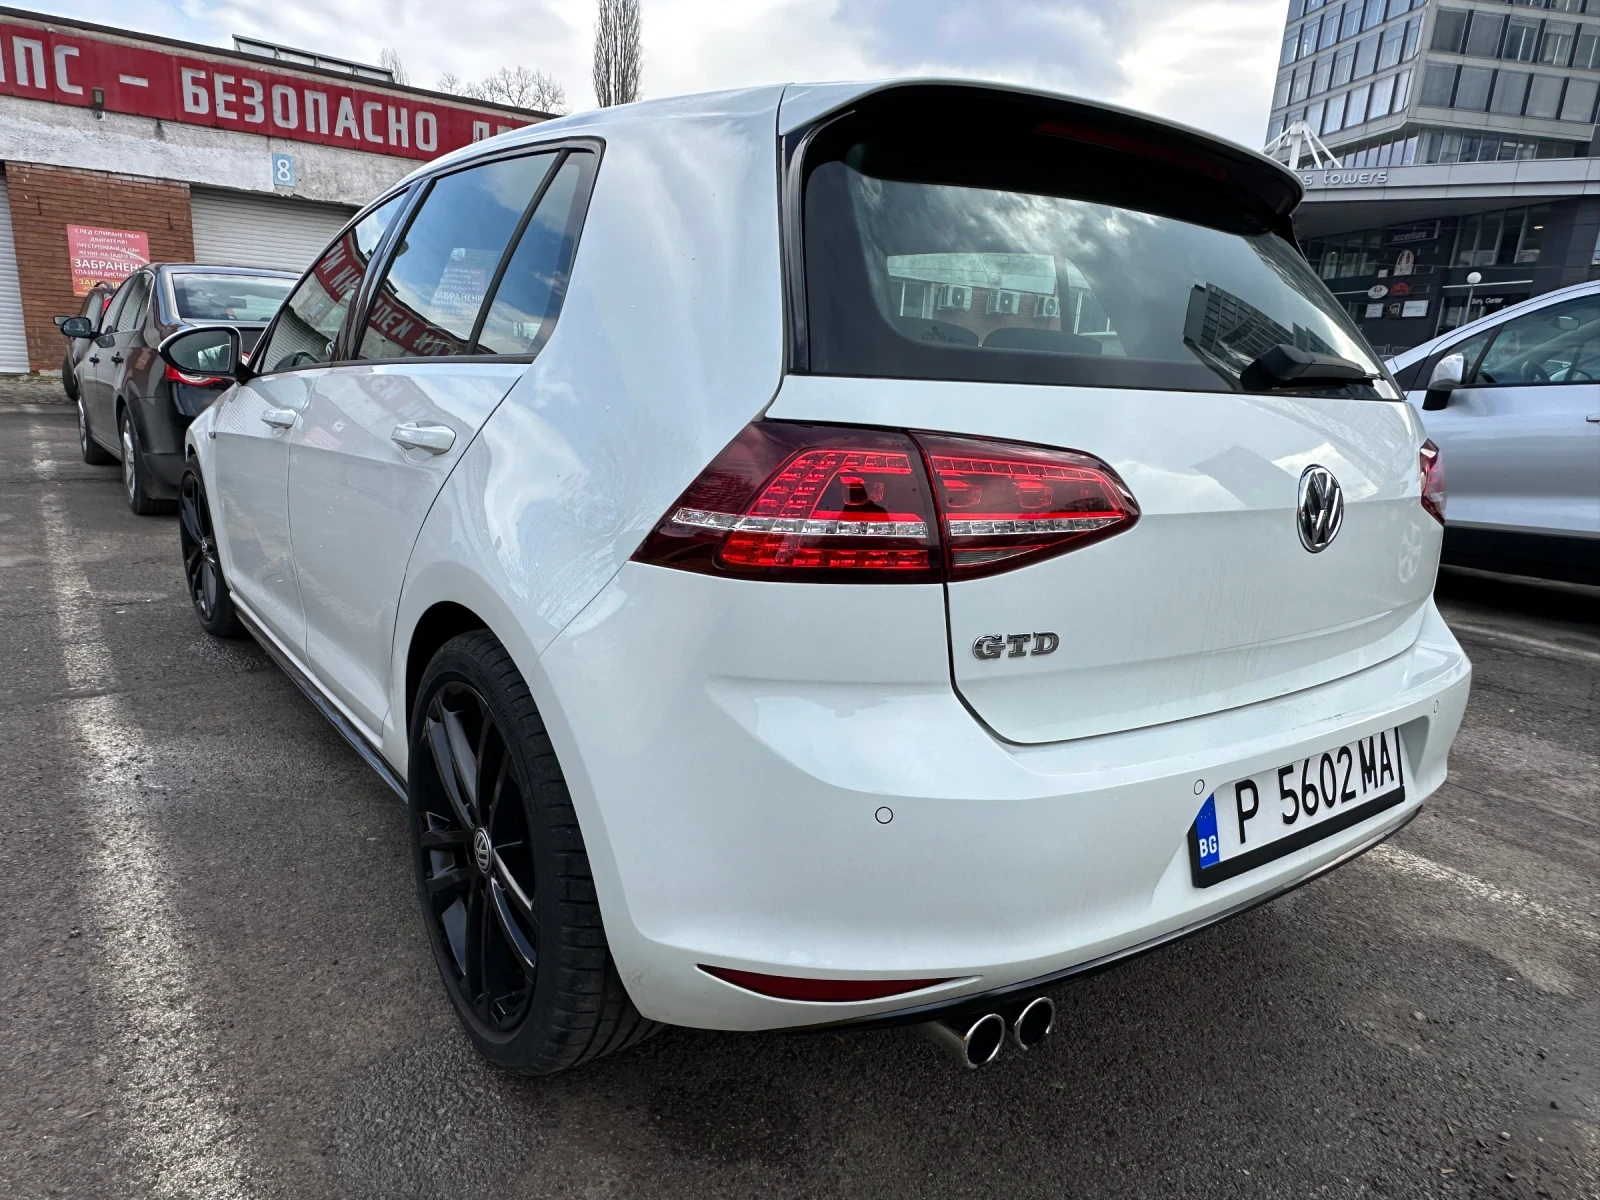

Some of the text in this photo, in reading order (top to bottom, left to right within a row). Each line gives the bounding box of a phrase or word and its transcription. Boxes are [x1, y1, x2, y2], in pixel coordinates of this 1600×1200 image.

[0, 35, 84, 95] ПС
[181, 67, 438, 152] БЕЗОПАСНО
[276, 158, 291, 182] 8
[1323, 170, 1388, 185] towers
[94, 230, 123, 238] СПИРАНЕ
[1392, 230, 1427, 242] accenture
[972, 631, 1060, 660] GTD
[1234, 778, 1260, 844] P
[1199, 835, 1218, 857] BG
